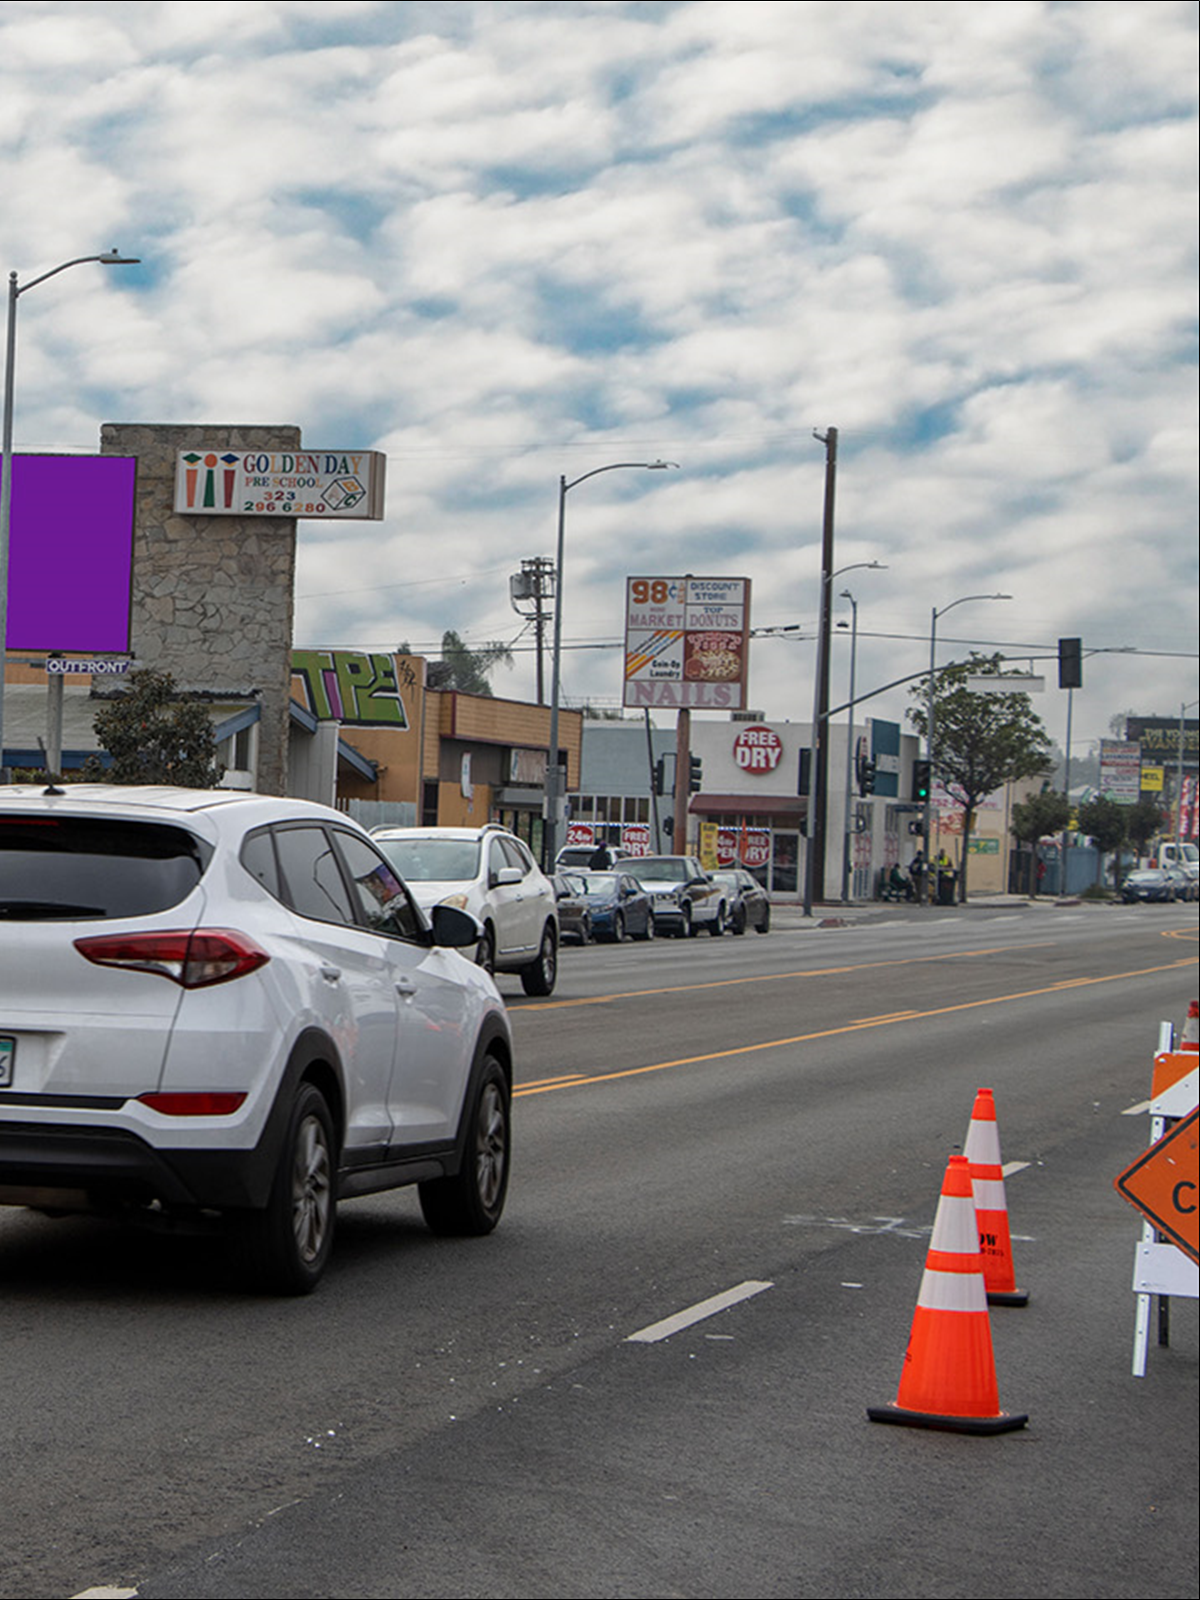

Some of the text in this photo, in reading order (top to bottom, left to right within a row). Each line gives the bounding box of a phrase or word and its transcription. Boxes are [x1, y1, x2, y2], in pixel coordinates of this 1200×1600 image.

[243, 454, 363, 474] GOLDEN DAY
[245, 477, 323, 488] PRE SCHOOL
[264, 491, 296, 501] 323
[244, 501, 326, 513] 296 6280
[690, 582, 740, 591] DISCOUNT
[695, 592, 727, 601] STORE
[704, 606, 724, 614] TOP
[630, 614, 683, 627] MARKET
[690, 614, 739, 627] DONUTS
[48, 660, 127, 673] OUTFRONT
[650, 669, 680, 679] Laundry
[633, 682, 732, 706] NAILS
[739, 731, 777, 746] FREE
[736, 747, 781, 769] DRY
[625, 832, 647, 841] FREE
